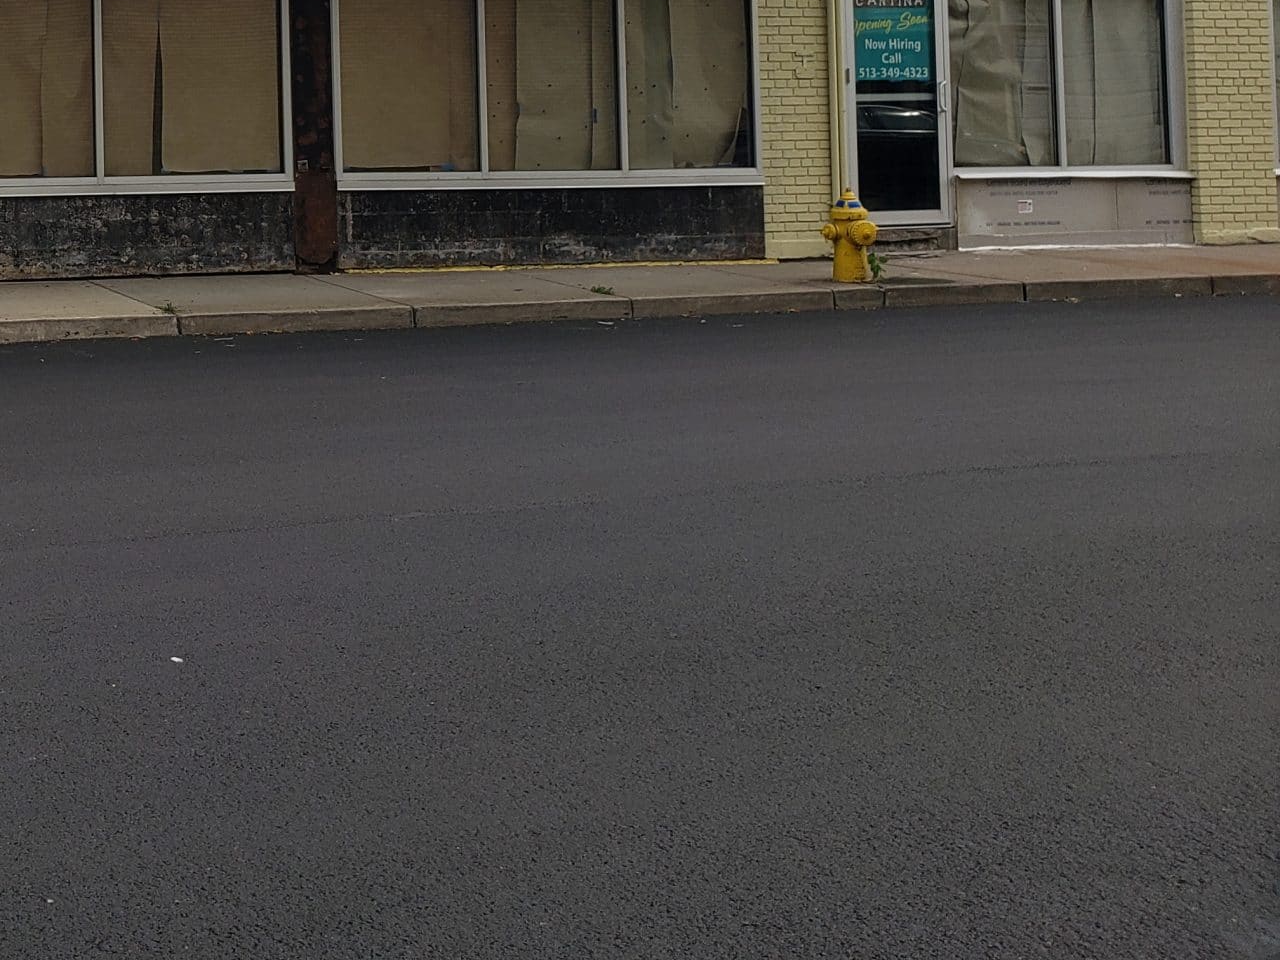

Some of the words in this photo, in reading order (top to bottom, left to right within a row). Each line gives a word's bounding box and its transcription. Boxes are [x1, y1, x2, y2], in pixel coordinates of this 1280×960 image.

[865, 39, 886, 50] Now
[889, 38, 921, 52] Hiring
[882, 53, 901, 64] Call
[859, 67, 928, 78] 513-349-4323
